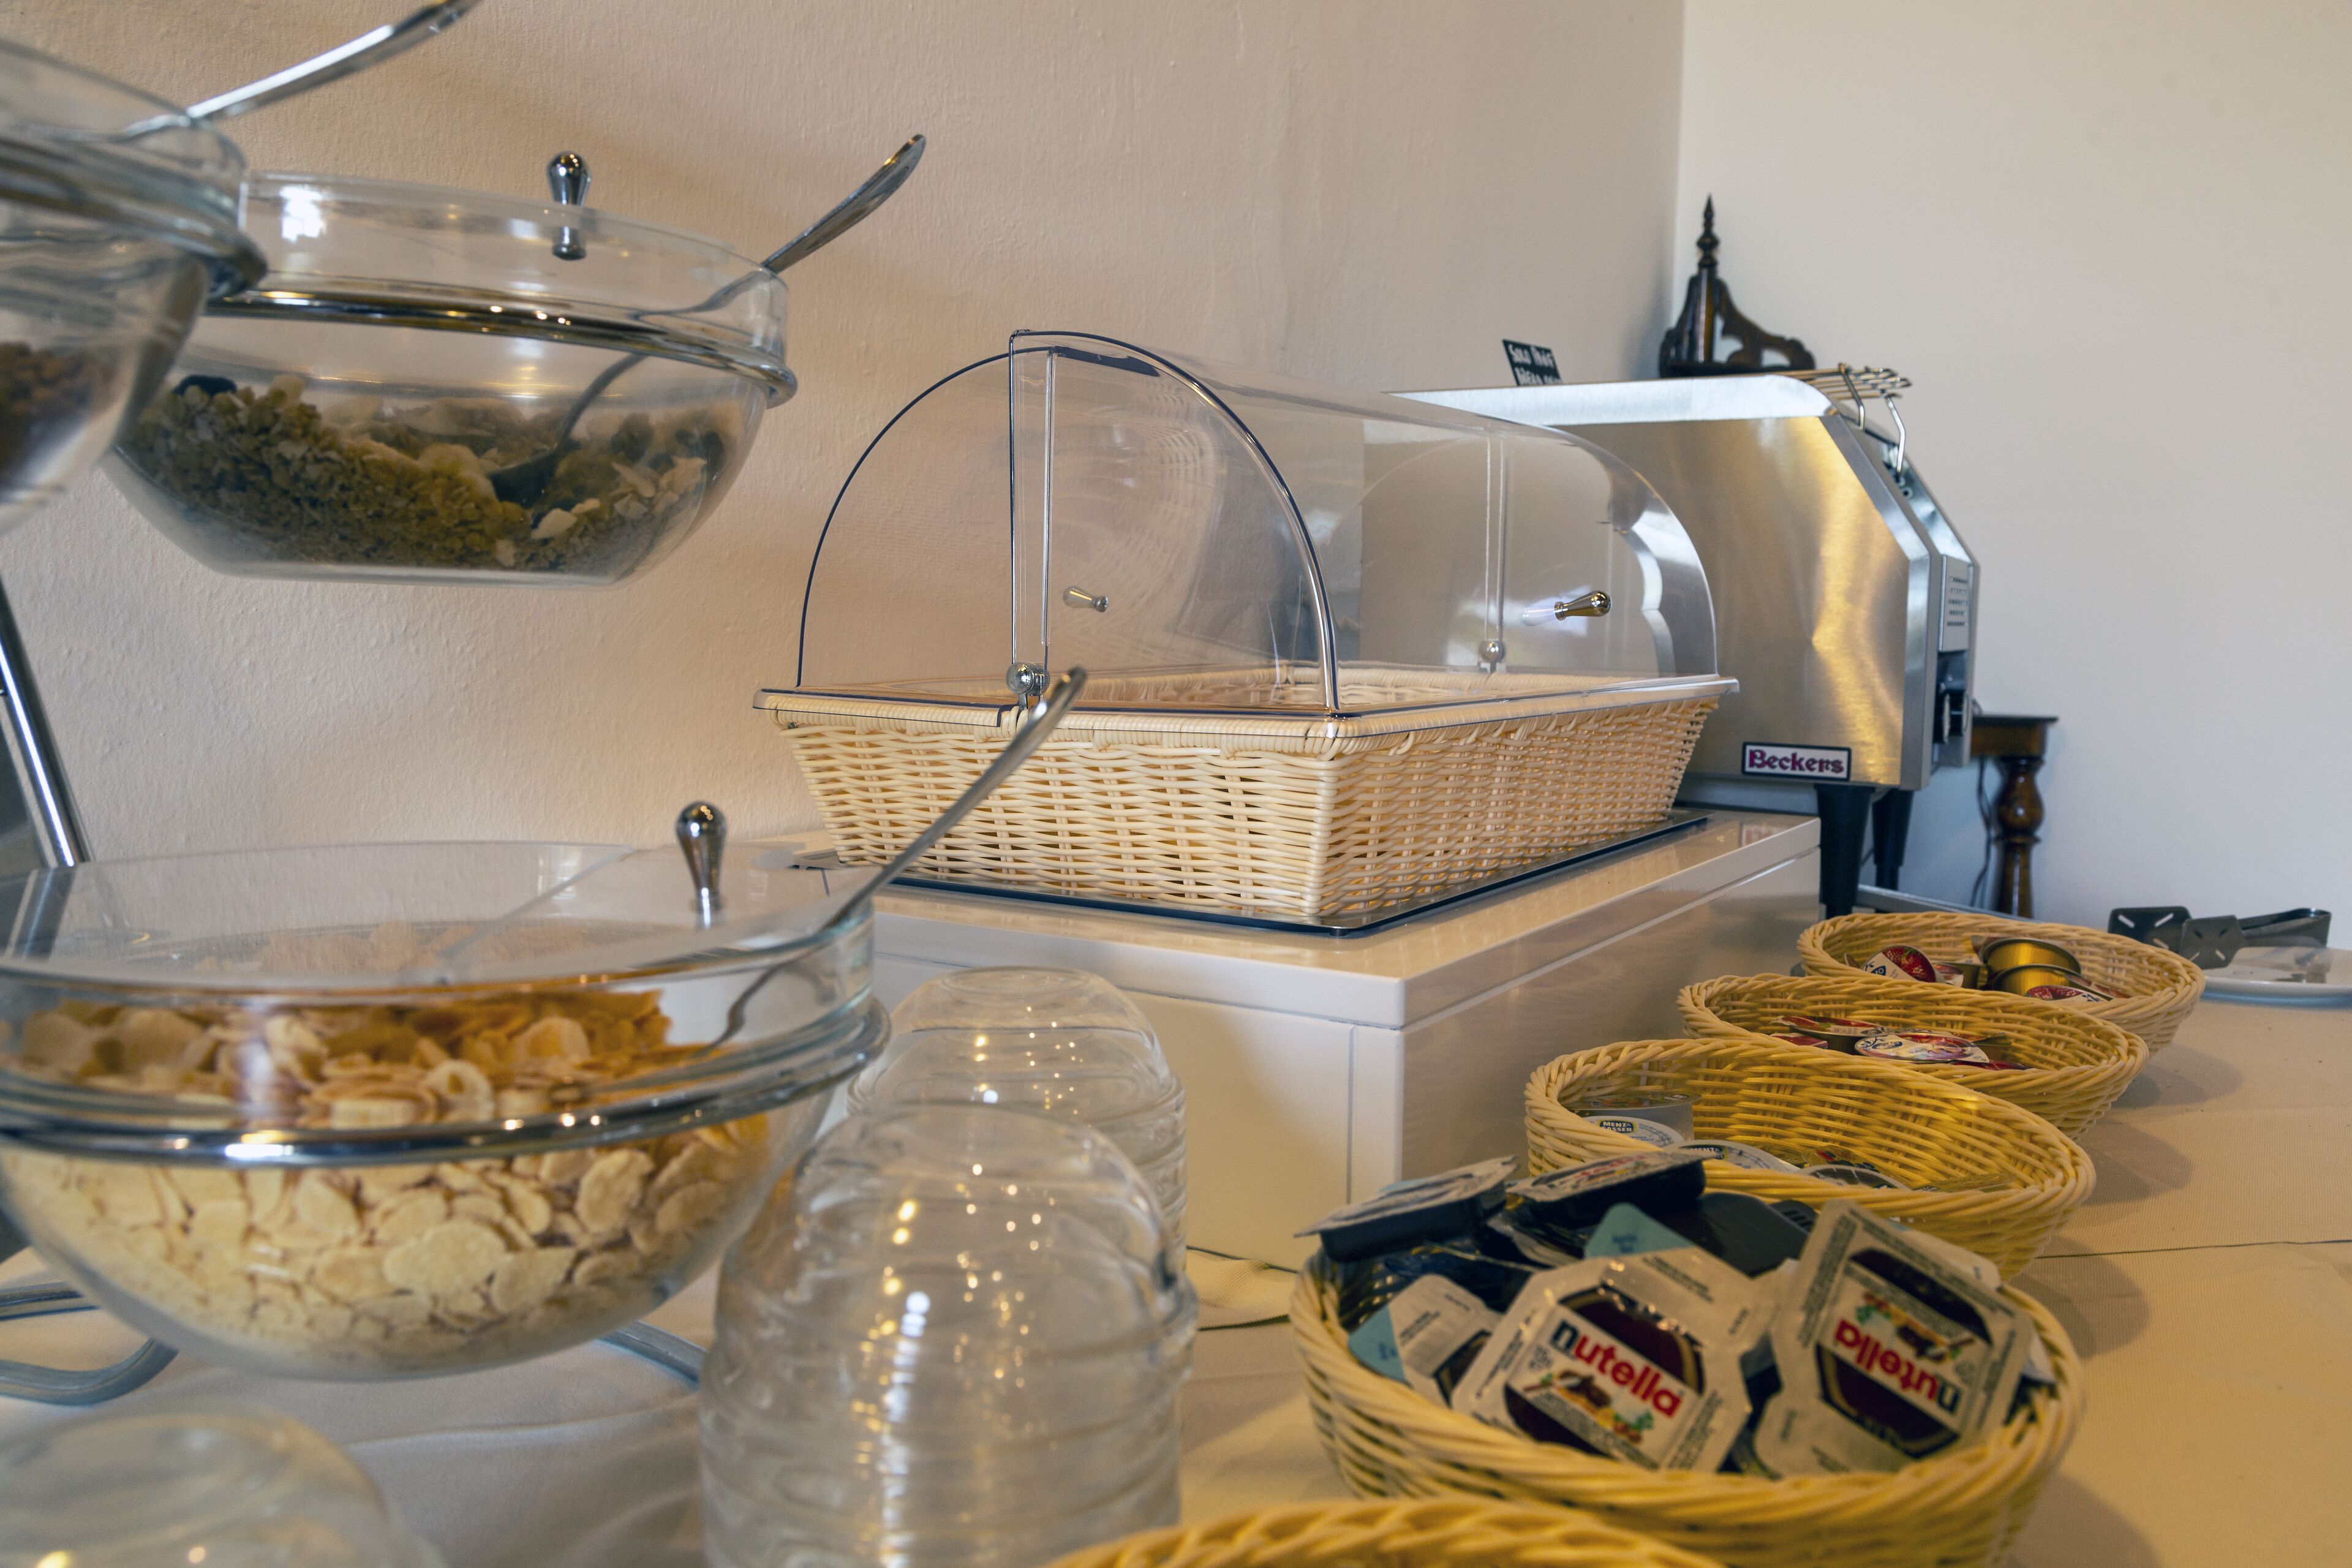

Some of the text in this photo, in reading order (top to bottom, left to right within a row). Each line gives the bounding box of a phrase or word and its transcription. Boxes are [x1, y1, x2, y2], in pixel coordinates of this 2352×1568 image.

[1749, 748, 1844, 773] Beckers
[1551, 1320, 1681, 1418] nutella
[1834, 1319, 1961, 1413] nutella
